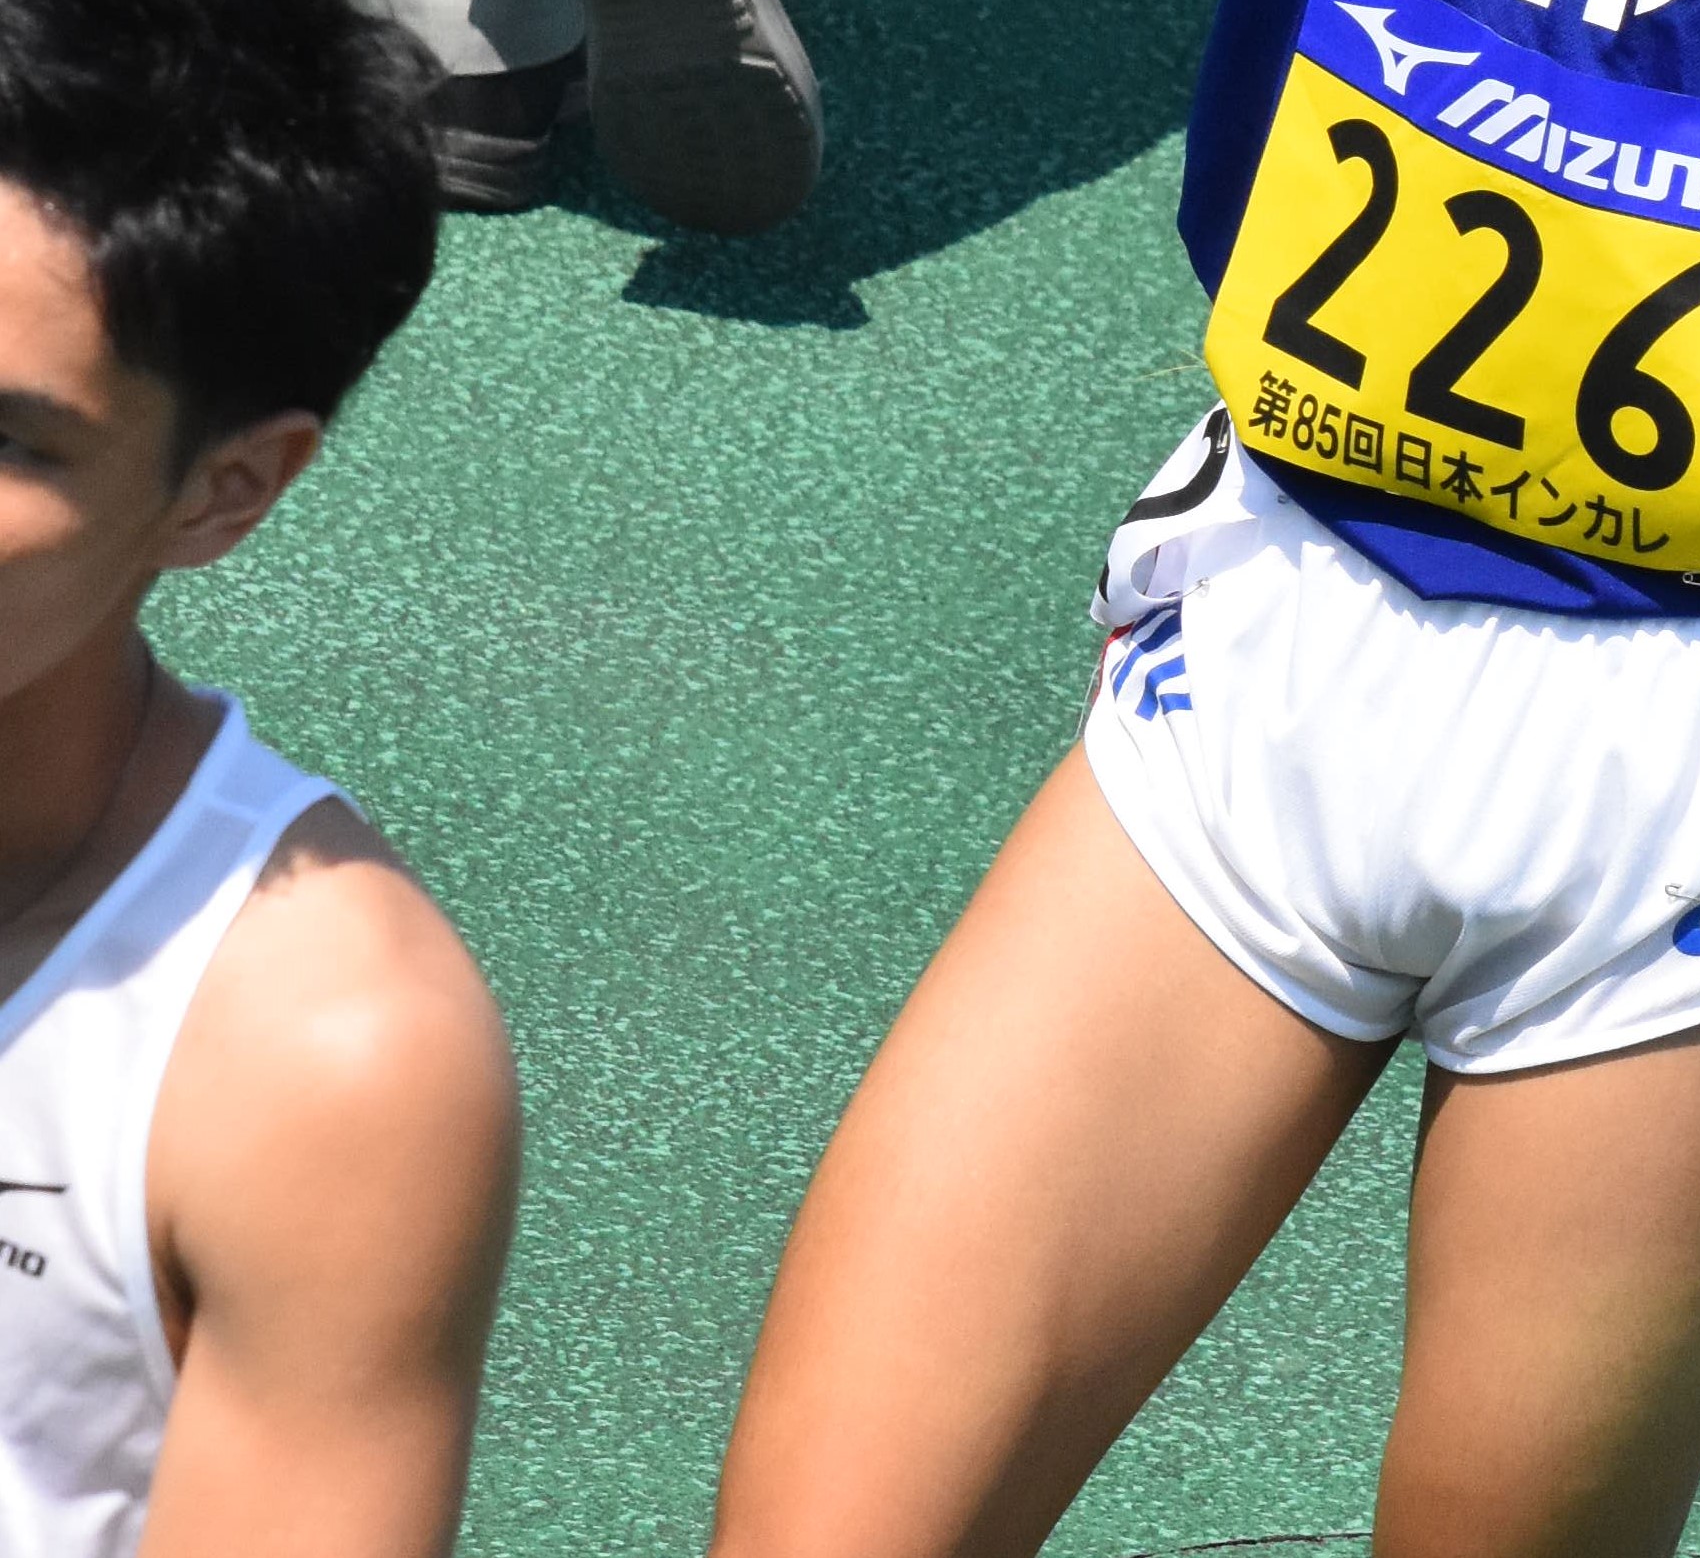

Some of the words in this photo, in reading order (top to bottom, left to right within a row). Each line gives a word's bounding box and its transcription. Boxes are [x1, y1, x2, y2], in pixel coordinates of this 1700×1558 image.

[1248, 370, 1670, 554] 第85回日本インカレ
